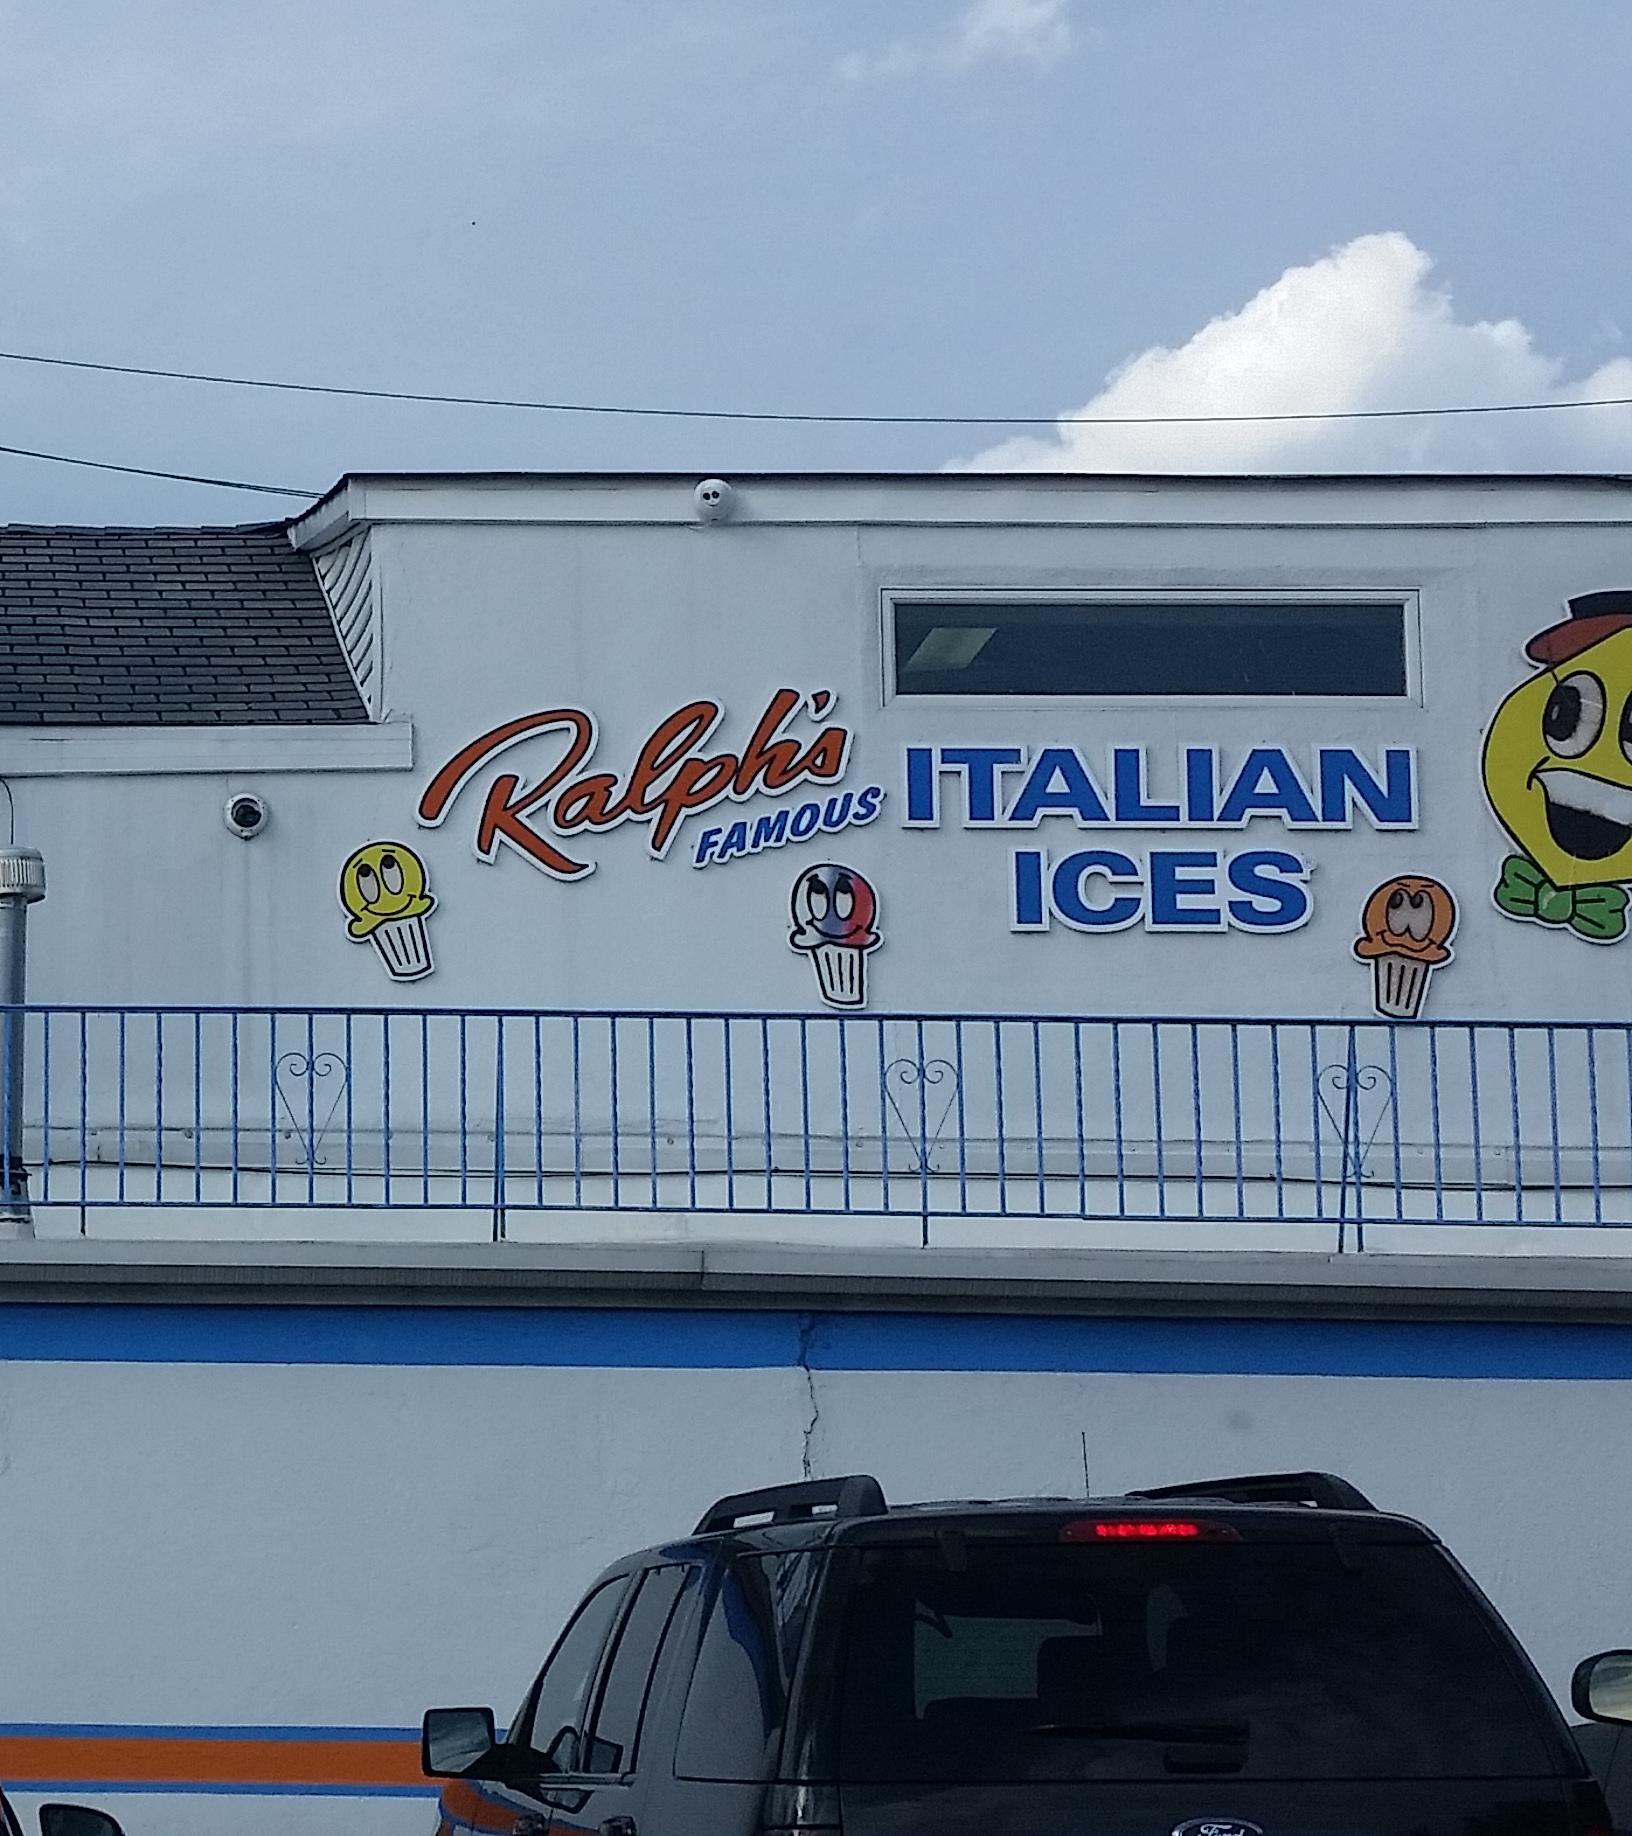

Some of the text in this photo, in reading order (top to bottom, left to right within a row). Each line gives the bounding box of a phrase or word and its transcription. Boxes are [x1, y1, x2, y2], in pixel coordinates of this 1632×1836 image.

[418, 687, 848, 875] Ralph's
[903, 746, 1416, 826] ITALIAN
[693, 786, 884, 867] FAMOUS
[1014, 850, 1310, 929] ICES
